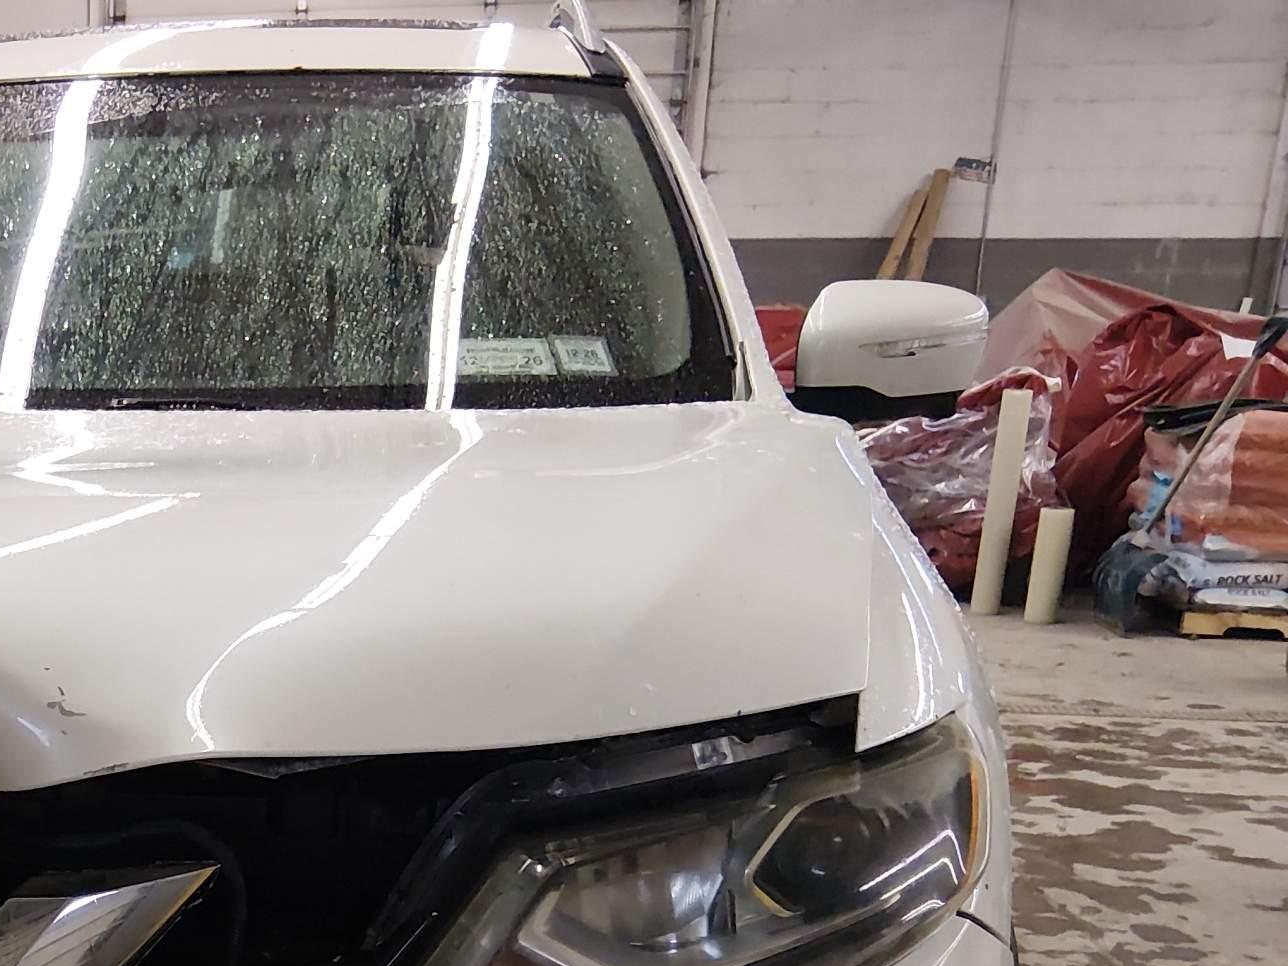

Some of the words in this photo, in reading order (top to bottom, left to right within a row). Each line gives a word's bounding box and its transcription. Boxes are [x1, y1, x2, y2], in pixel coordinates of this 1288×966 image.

[522, 355, 544, 367] 26
[1216, 575, 1251, 585] ROCK
[1254, 574, 1284, 585] SALT
